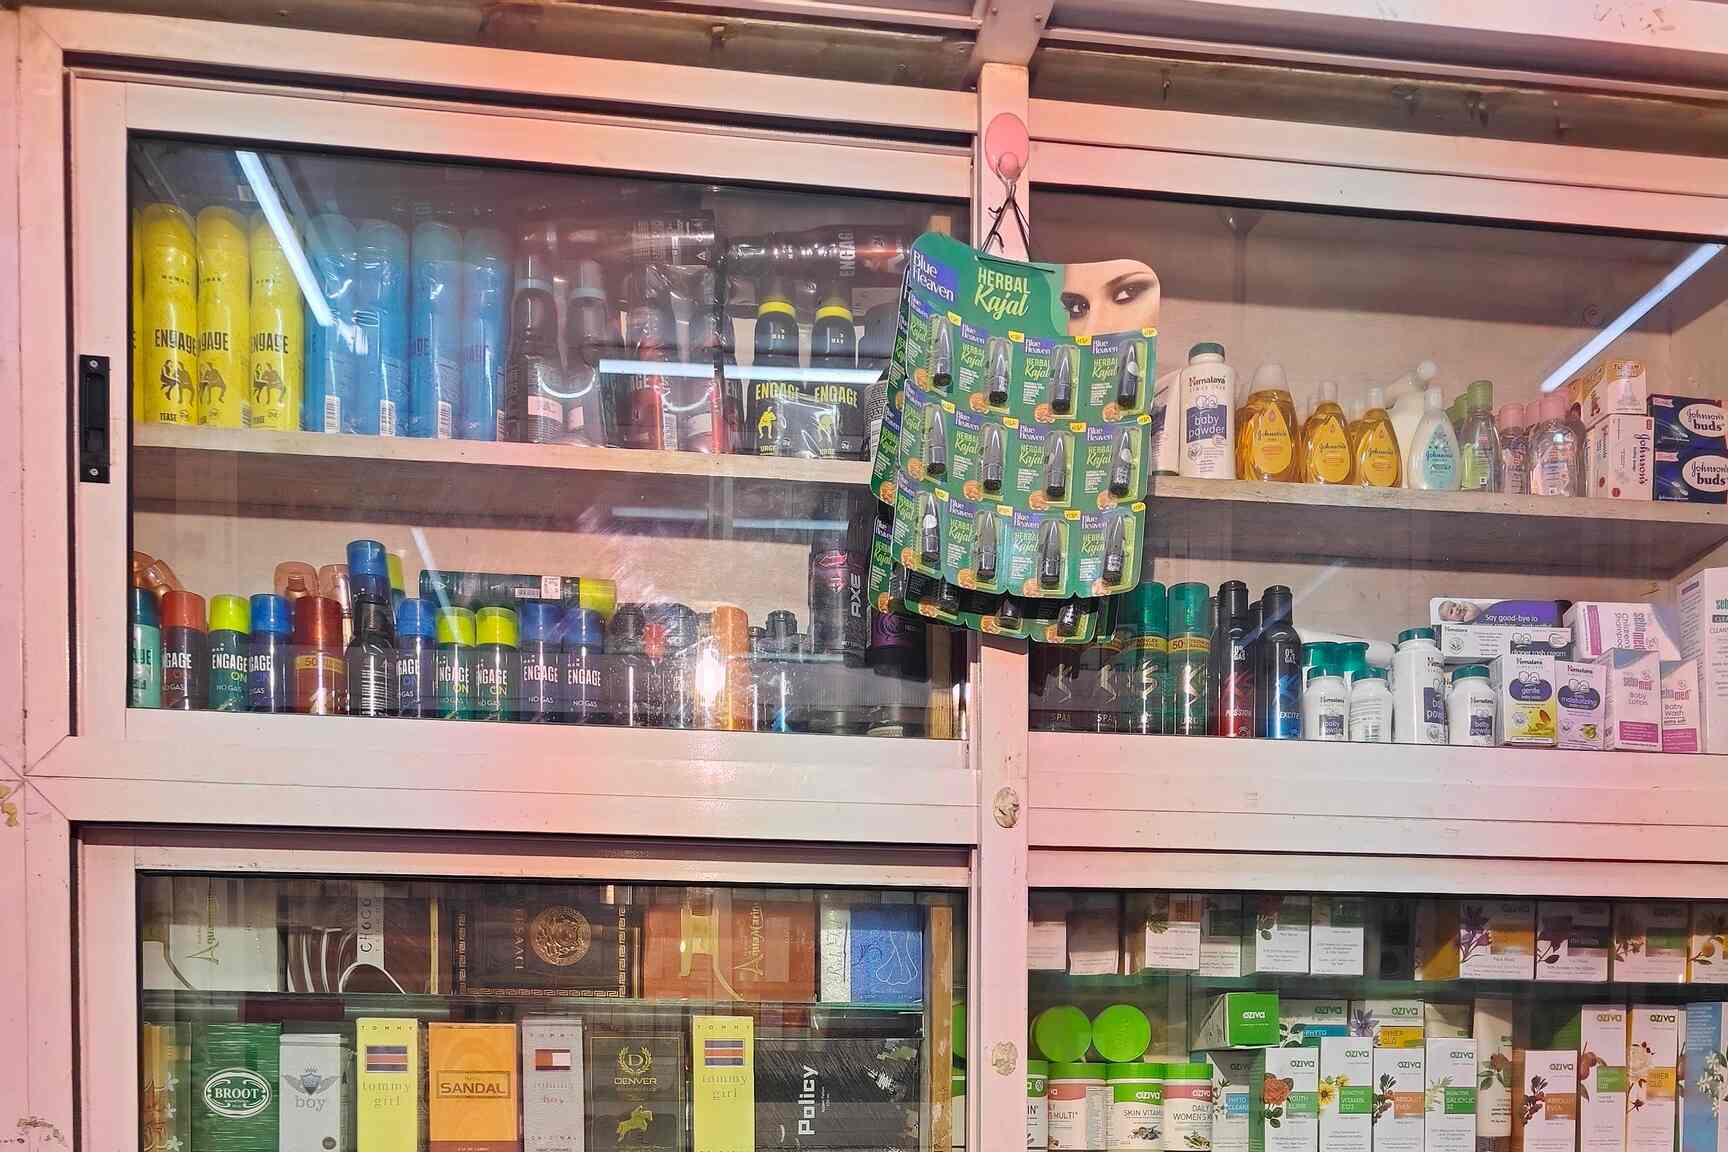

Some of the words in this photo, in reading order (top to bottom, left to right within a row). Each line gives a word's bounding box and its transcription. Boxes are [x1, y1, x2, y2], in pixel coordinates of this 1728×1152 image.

[913, 251, 938, 276] Blue
[912, 267, 954, 302] Heaven
[978, 268, 1031, 294] HERBAL
[974, 284, 1029, 320] Kajal
[155, 329, 197, 355] ENGAGE
[1195, 415, 1220, 426] baby
[1686, 409, 1725, 422] Johnson's
[1189, 426, 1225, 437] powder
[1693, 421, 1722, 431] buds
[1635, 432, 1650, 485] Johnson's
[1697, 472, 1726, 485] buds
[849, 575, 861, 617] AXE
[212, 657, 247, 672] ENGAGE
[523, 666, 558, 682] ENGAGE
[568, 671, 600, 686] ENGAGE
[363, 1080, 411, 1093] tommy
[614, 1077, 656, 1085] DENVER
[702, 1075, 747, 1086] tommy
[215, 1088, 259, 1098] BROOT
[441, 1081, 505, 1094] SANDAL
[712, 1088, 738, 1100] girl
[295, 1095, 325, 1112] boy
[374, 1095, 402, 1108] girl
[799, 1064, 819, 1136] Policy
[1123, 1110, 1136, 1118] SKIN
